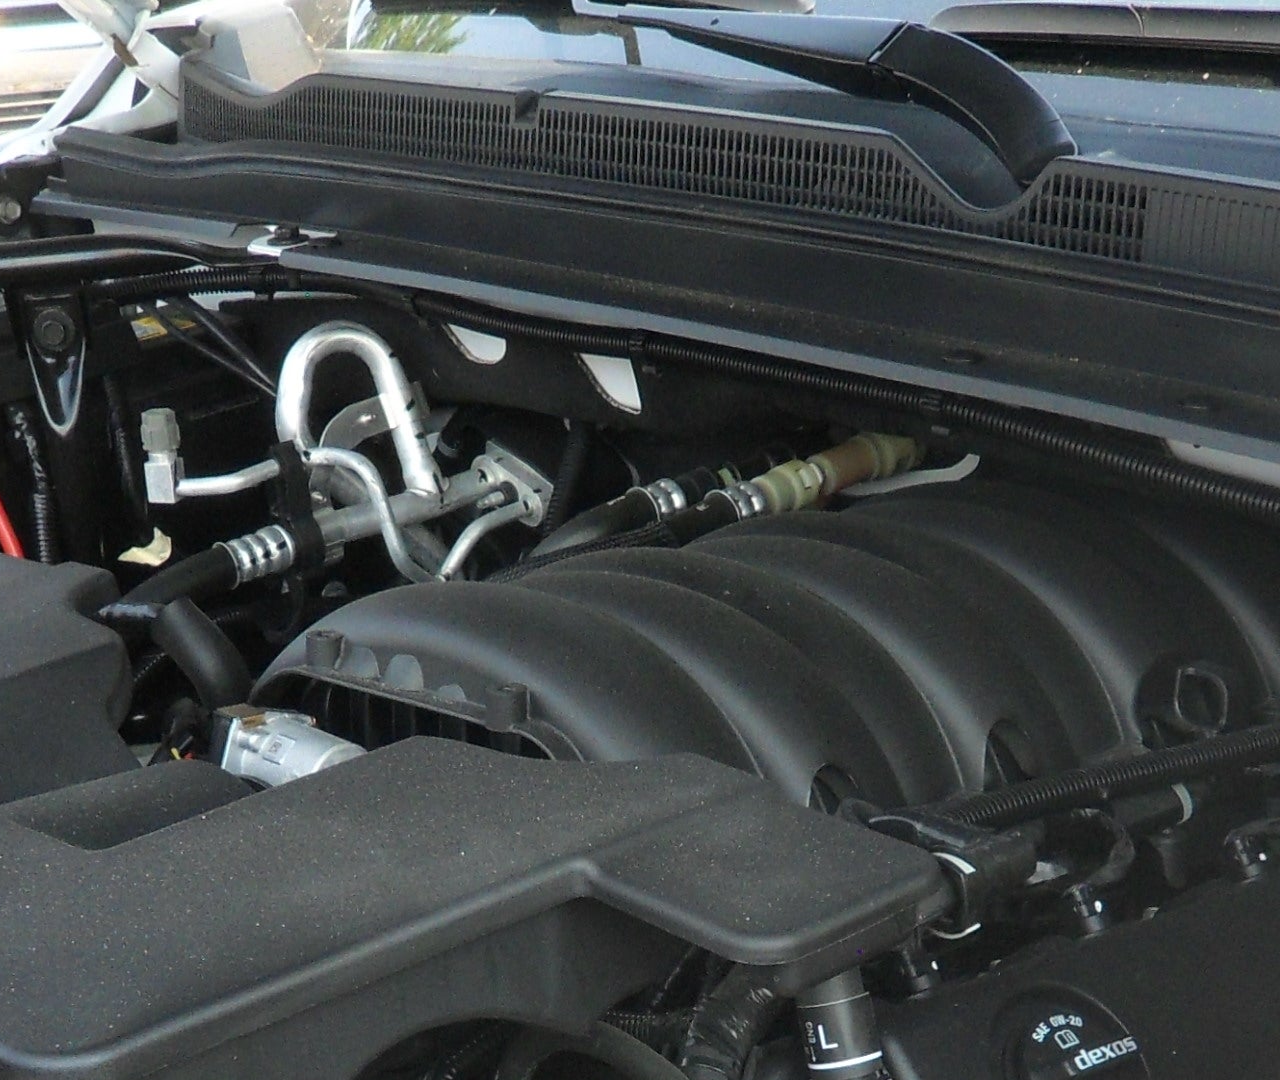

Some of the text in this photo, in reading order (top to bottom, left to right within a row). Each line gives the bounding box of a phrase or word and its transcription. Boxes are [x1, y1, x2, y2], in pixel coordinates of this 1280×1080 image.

[818, 1024, 839, 1050] L
[1032, 1014, 1084, 1043] SAE 0W-20
[1074, 1036, 1138, 1071] dexos
